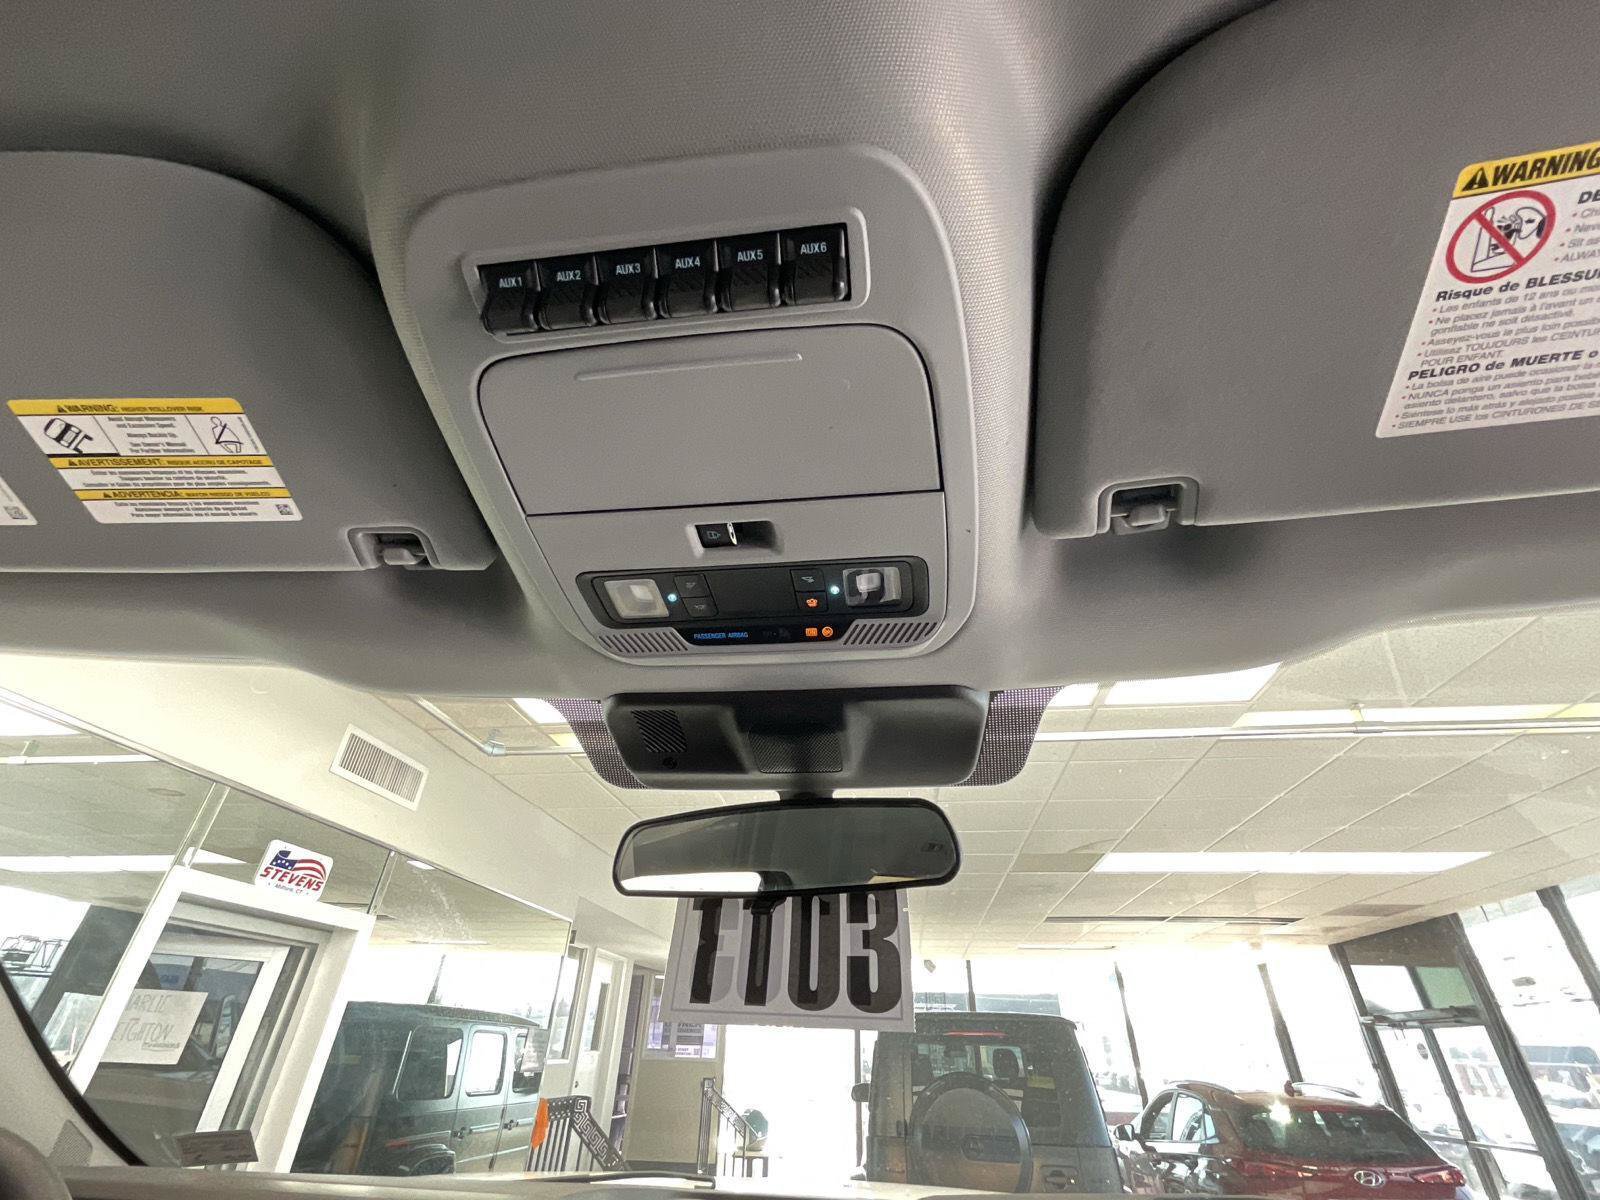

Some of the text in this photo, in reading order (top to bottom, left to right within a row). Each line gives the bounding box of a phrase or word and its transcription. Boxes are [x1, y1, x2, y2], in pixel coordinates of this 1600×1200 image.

[1492, 147, 1600, 187] WARNING
[800, 242, 827, 255] AUX6
[737, 249, 764, 262] AUX5
[615, 262, 641, 276] AUX3
[675, 257, 701, 270] AUX4
[555, 269, 582, 282] AUX2
[498, 276, 523, 289] AUX1
[1436, 286, 1493, 302] Risque
[1499, 281, 1520, 293] de
[1407, 363, 1480, 381] PELIGRO
[1485, 360, 1505, 371] de
[1510, 349, 1584, 369] MUERTE
[1589, 350, 1599, 358] o
[693, 631, 749, 640] PASSENGER AIRBAG
[259, 866, 324, 892] STEVENS
